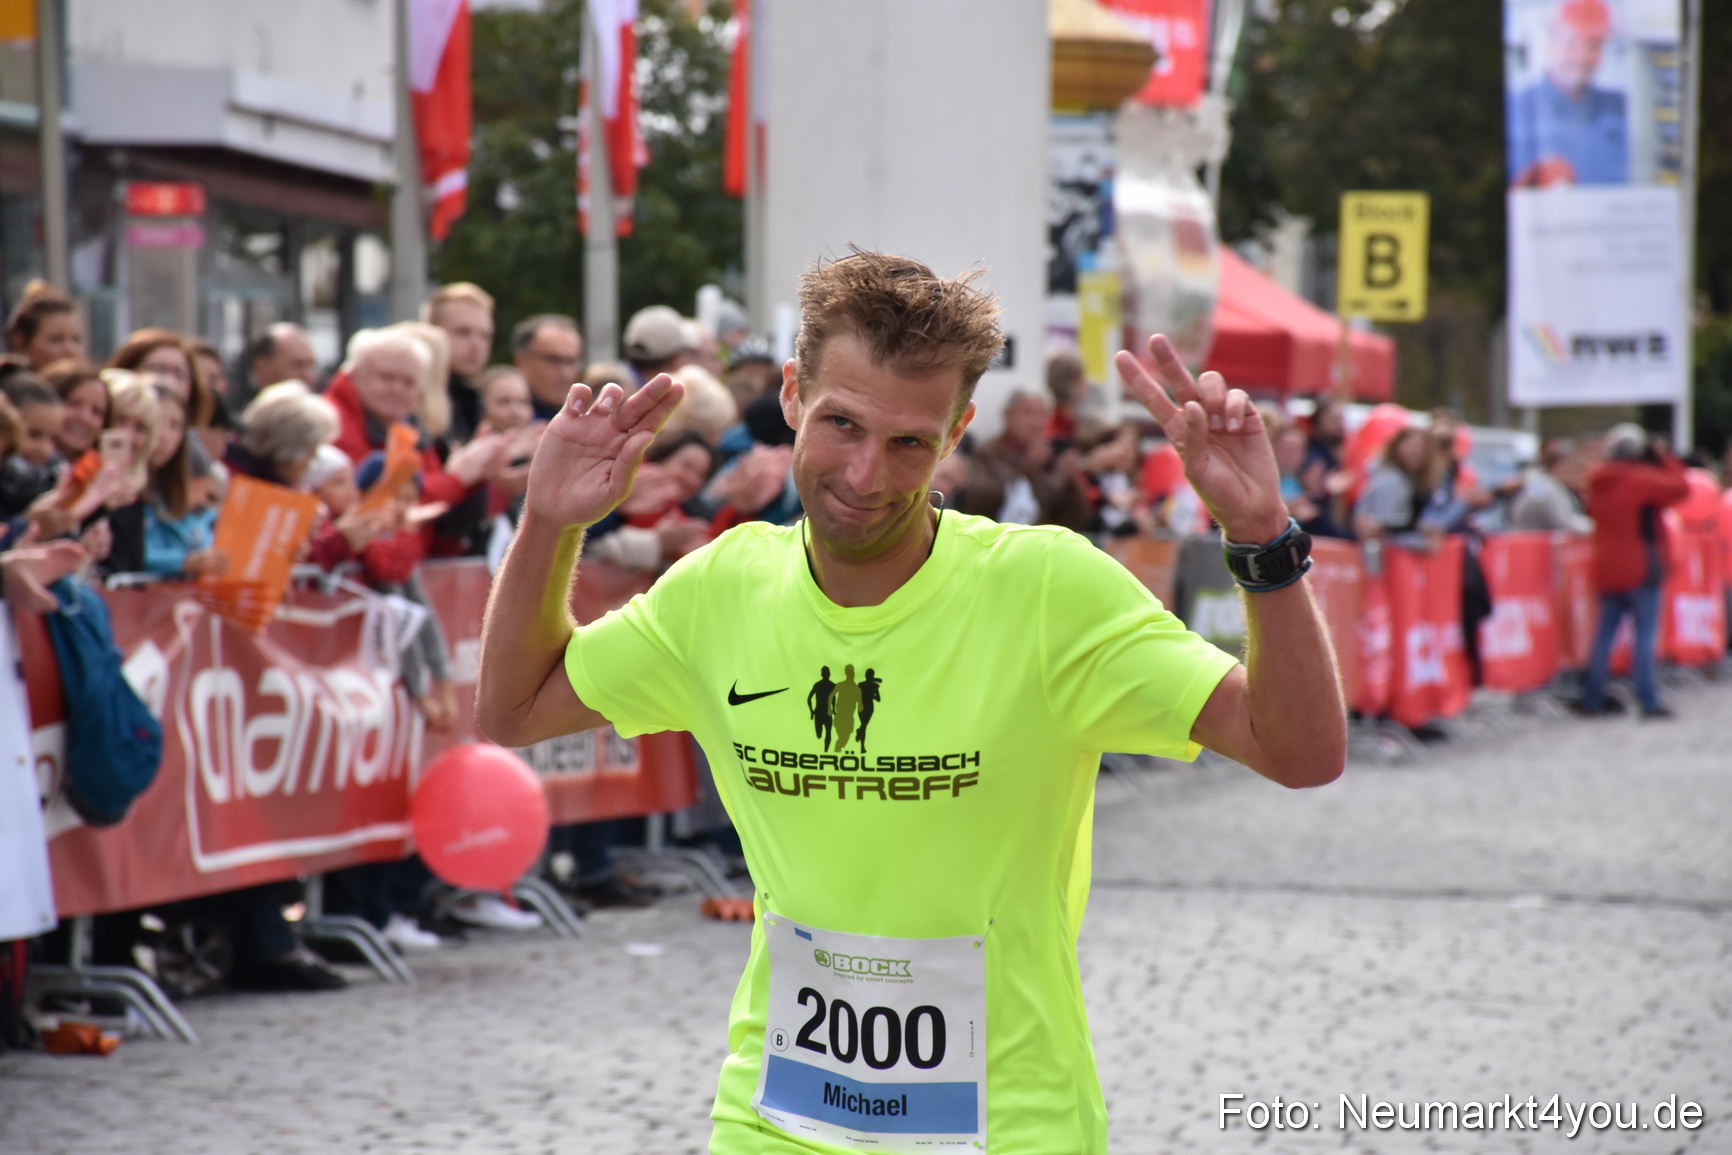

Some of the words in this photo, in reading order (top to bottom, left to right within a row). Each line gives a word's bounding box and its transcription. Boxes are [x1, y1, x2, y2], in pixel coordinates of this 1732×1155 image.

[1363, 234, 1401, 289] B
[732, 741, 757, 763] SC
[832, 952, 912, 978] BOCK
[833, 971, 855, 981] inspired
[856, 974, 864, 982] by
[884, 977, 914, 985] concepts
[776, 1034, 784, 1047] B
[795, 986, 947, 1070] 2000
[823, 1081, 908, 1117] Michael
